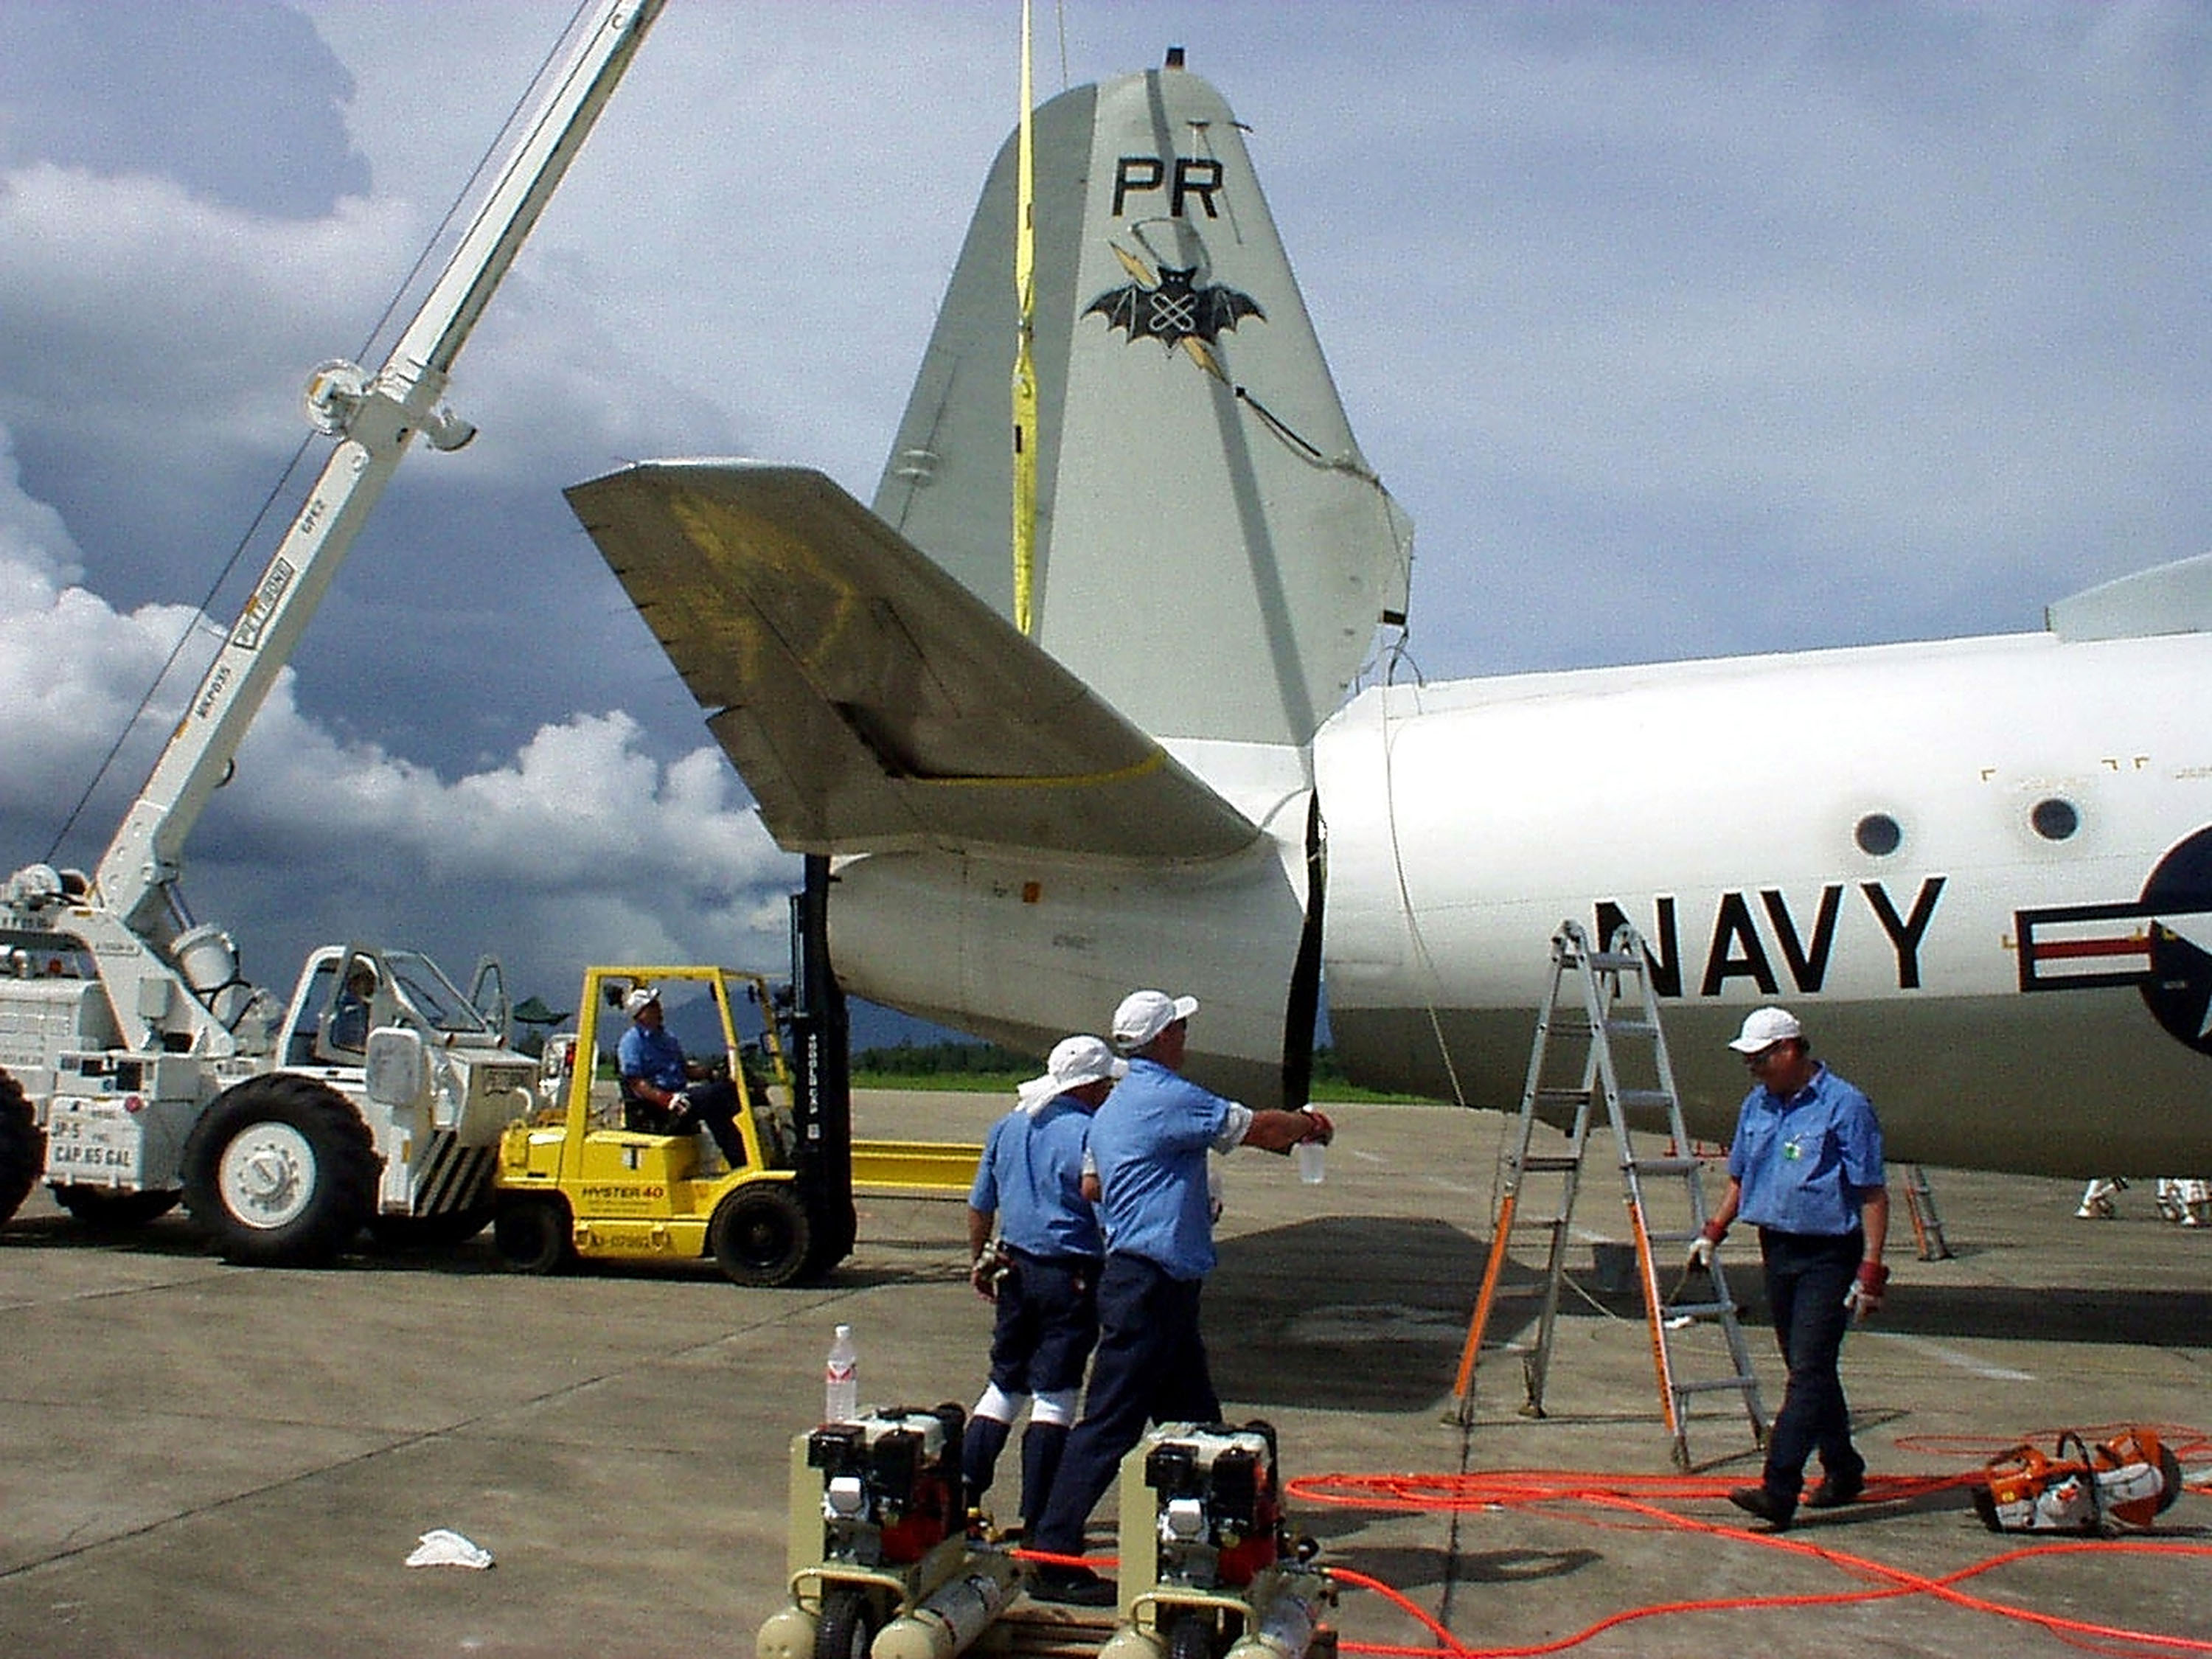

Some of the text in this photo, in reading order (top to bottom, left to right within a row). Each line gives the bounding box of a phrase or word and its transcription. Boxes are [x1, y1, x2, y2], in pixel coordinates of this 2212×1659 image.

[1113, 157, 1222, 218] PR
[1595, 877, 1947, 998] NAVY
[582, 1186, 664, 1198] HYSTER 40
